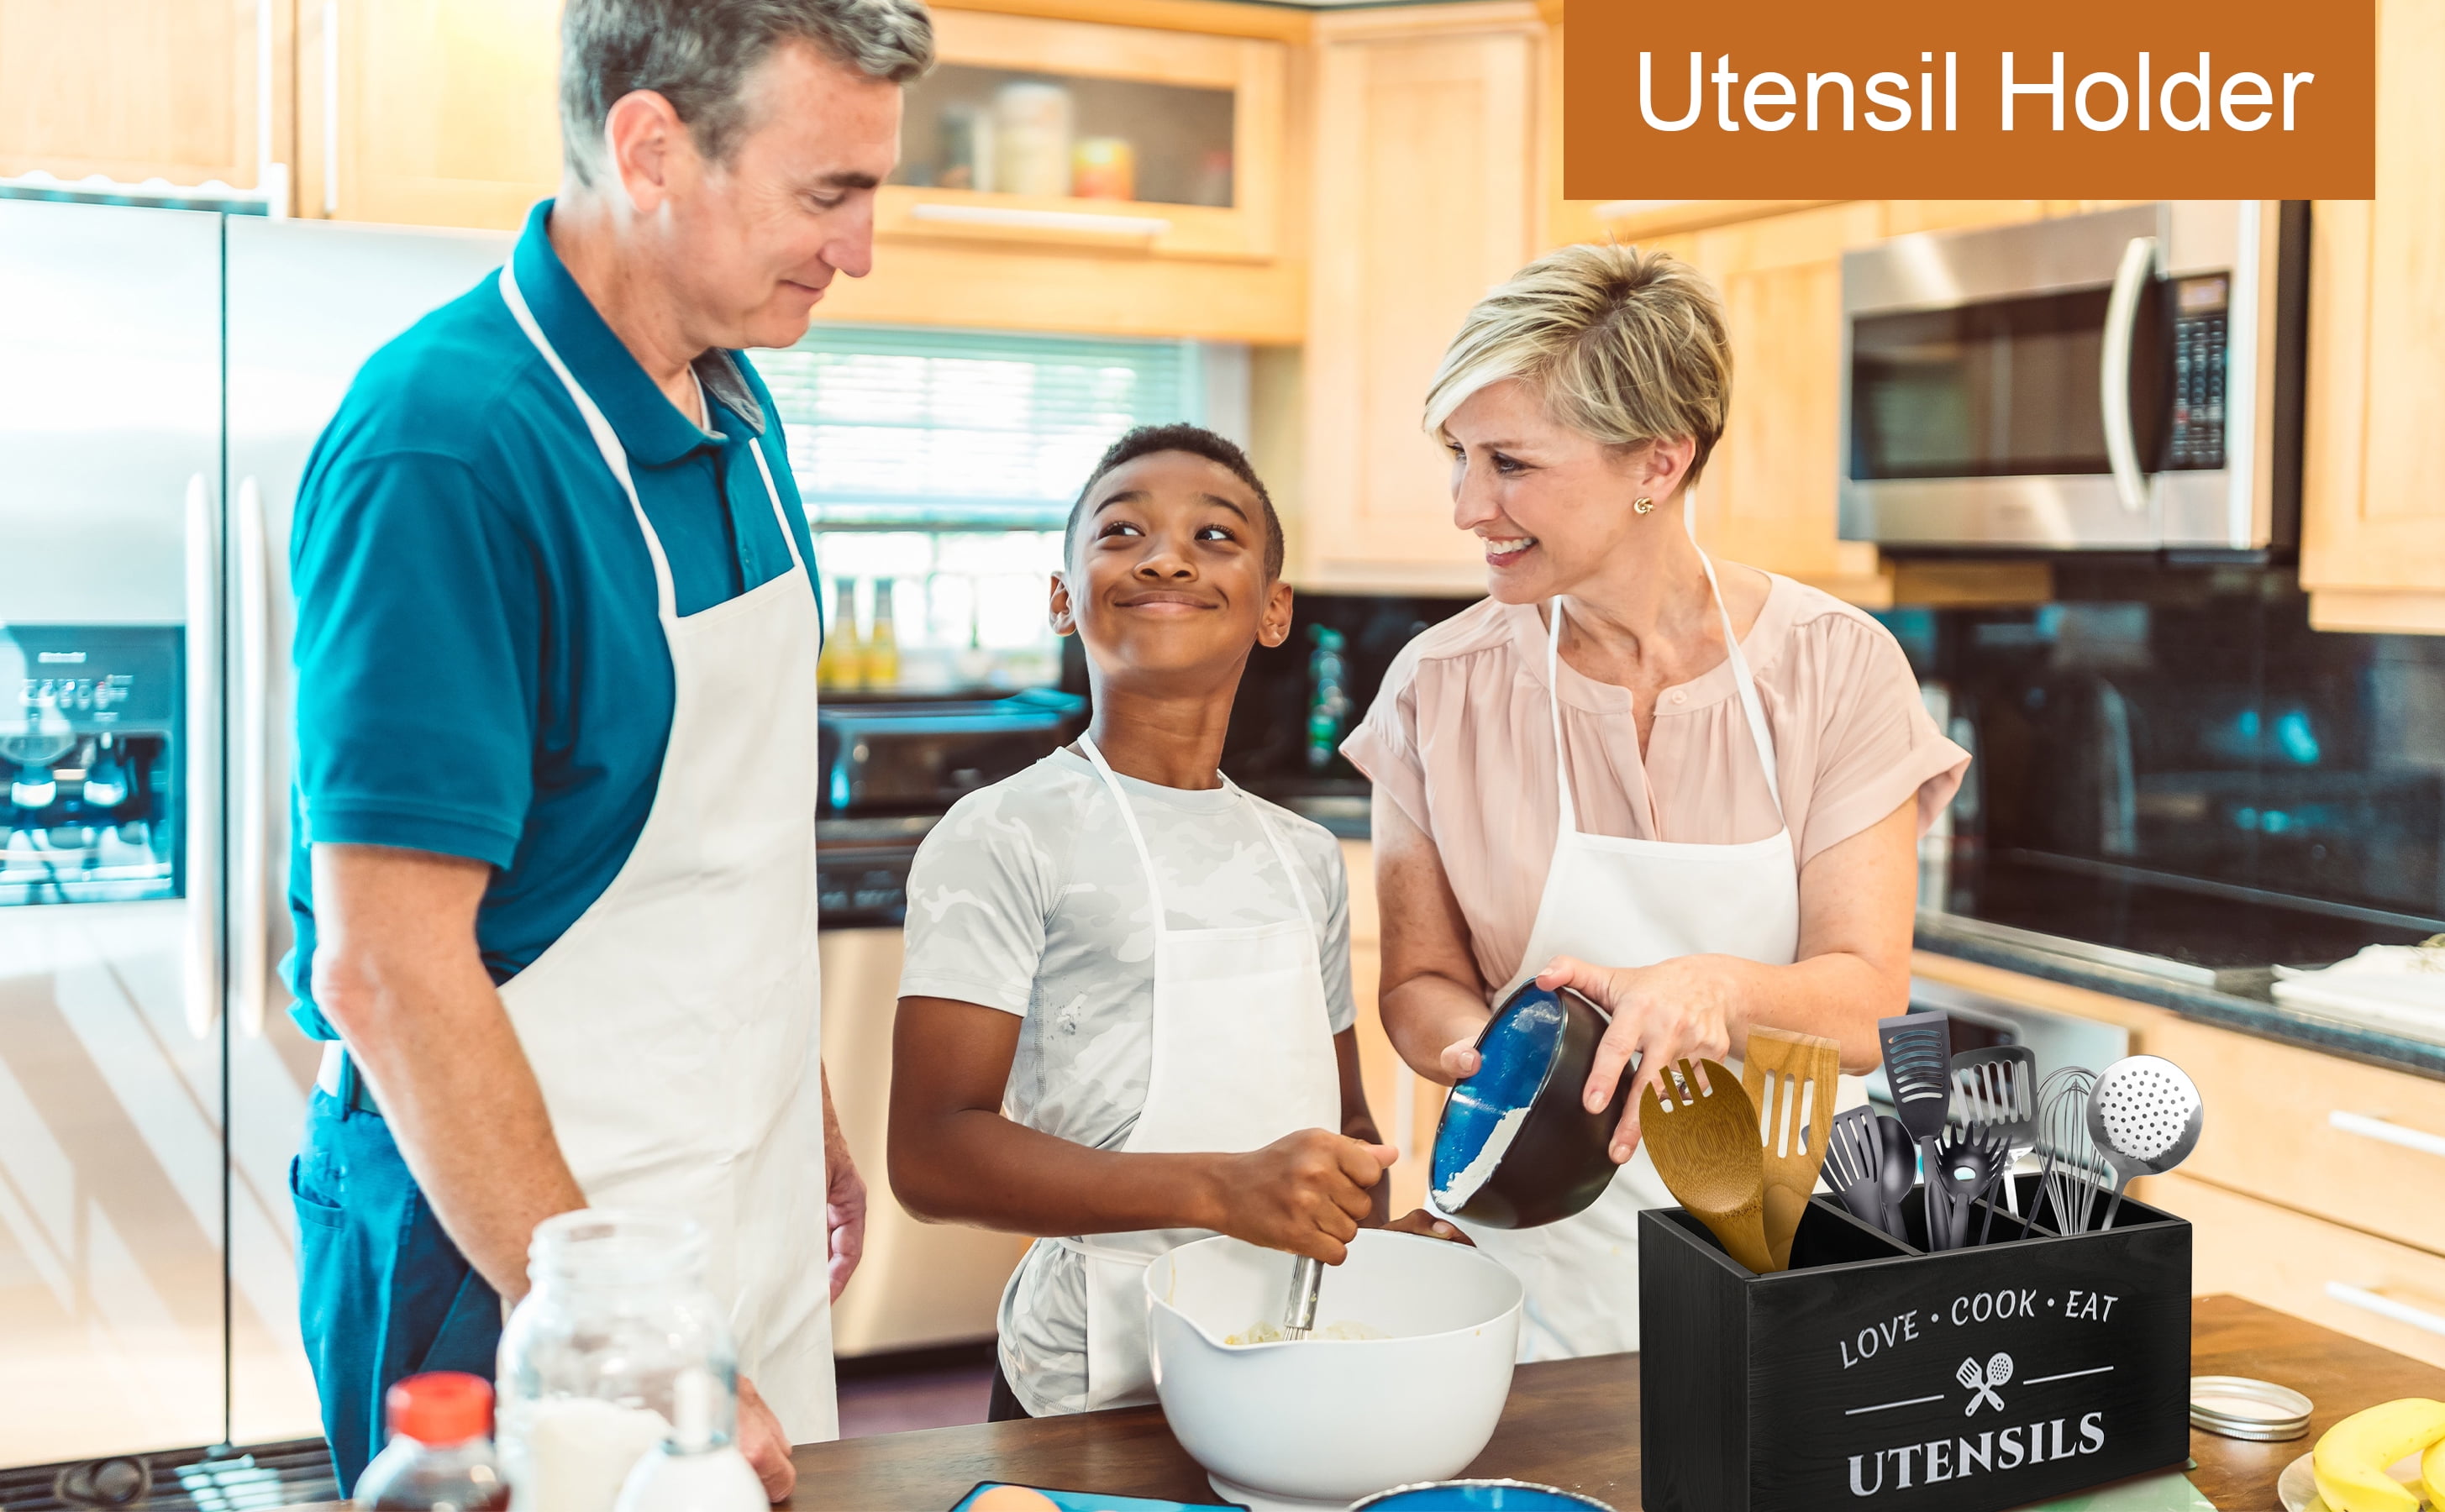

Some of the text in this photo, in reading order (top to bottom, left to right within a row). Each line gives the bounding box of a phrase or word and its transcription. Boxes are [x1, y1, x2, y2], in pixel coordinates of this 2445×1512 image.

[1840, 1289, 2119, 1369] LOVE COOK EAT
[1848, 1411, 2105, 1497] UTENSILS
